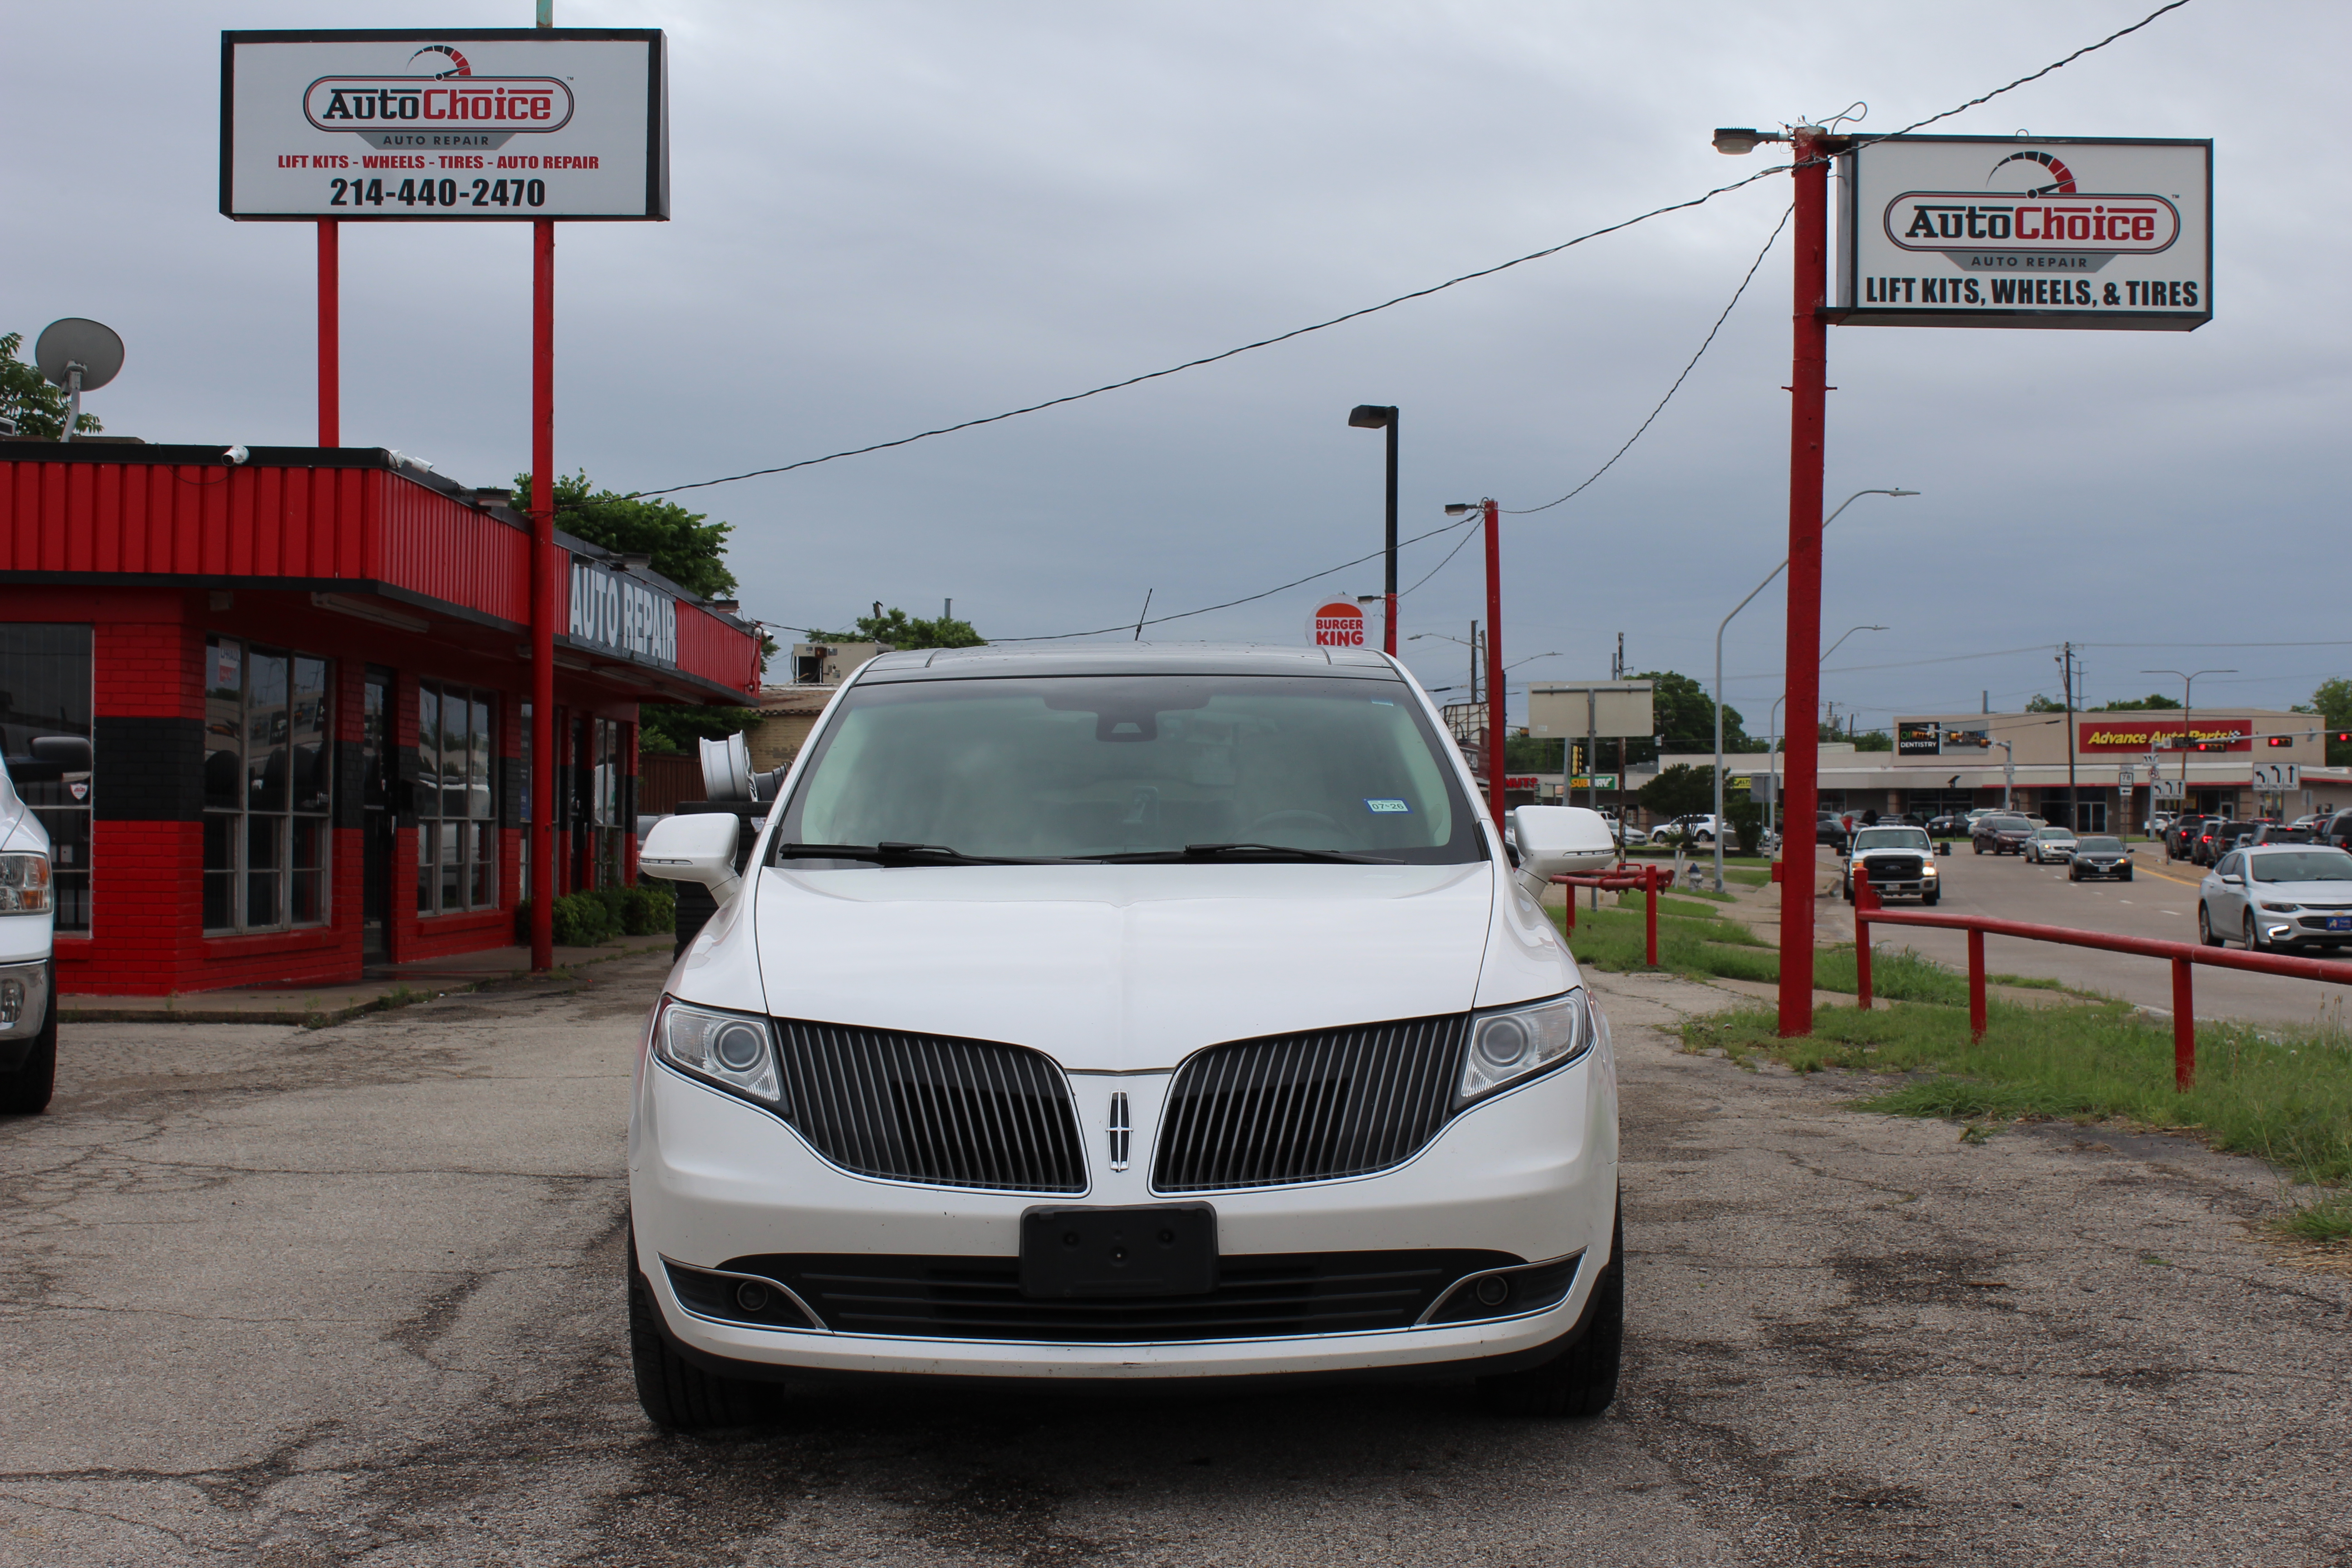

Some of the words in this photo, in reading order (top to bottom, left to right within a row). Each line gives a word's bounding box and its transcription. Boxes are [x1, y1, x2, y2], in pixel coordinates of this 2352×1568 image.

[323, 88, 553, 120] AutoChoice
[383, 136, 426, 145] AUTO
[433, 136, 489, 145] REPAIR
[278, 155, 309, 168] LIFT
[313, 155, 348, 168] KITS
[363, 155, 425, 168] WHEELS
[438, 156, 483, 168] TIRES
[497, 156, 538, 169] AUTO
[543, 156, 599, 169] REPAIR
[330, 178, 545, 206] 214-440-2470
[1905, 206, 2157, 240] AutoChoice
[1971, 256, 2017, 267] AUTO
[2026, 257, 2087, 268] REPAIR
[1866, 277, 1916, 303] LIFT
[1922, 278, 1985, 306] KITS,
[1991, 279, 2097, 308] WHEELS,
[2103, 282, 2121, 305] &
[2126, 280, 2198, 307] TIRES
[569, 563, 619, 648] AUTO
[624, 582, 676, 663] REPAIR
[1316, 619, 1363, 629] BURGER
[1316, 631, 1363, 647] KING
[2088, 731, 2147, 744] Advance
